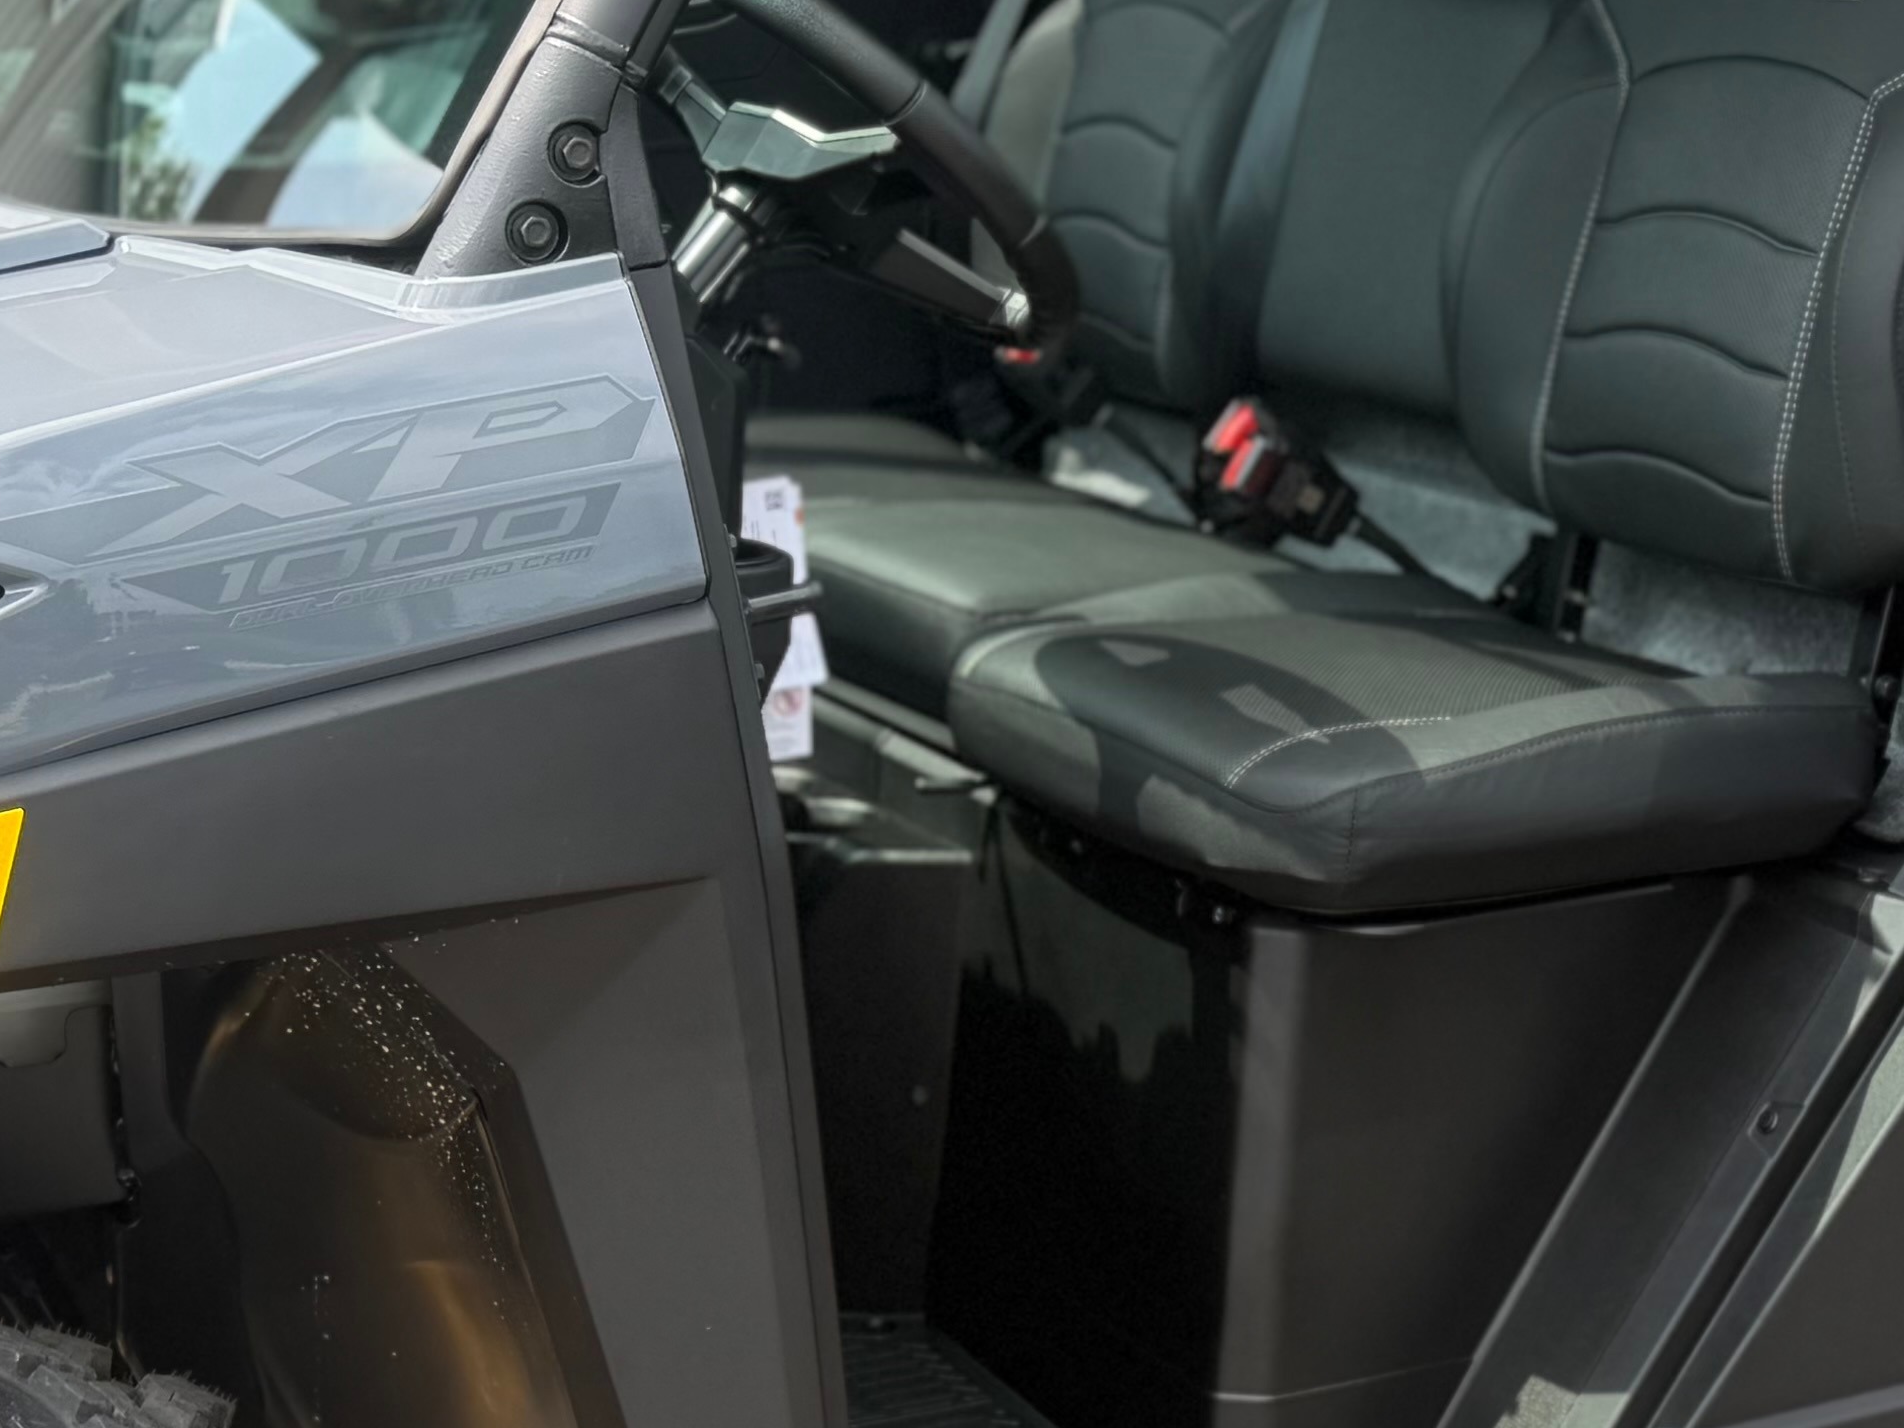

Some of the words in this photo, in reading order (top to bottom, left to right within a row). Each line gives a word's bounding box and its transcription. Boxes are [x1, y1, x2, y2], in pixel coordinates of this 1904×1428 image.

[88, 375, 634, 556] XP
[217, 495, 588, 604] 1000
[519, 545, 596, 571] CAM
